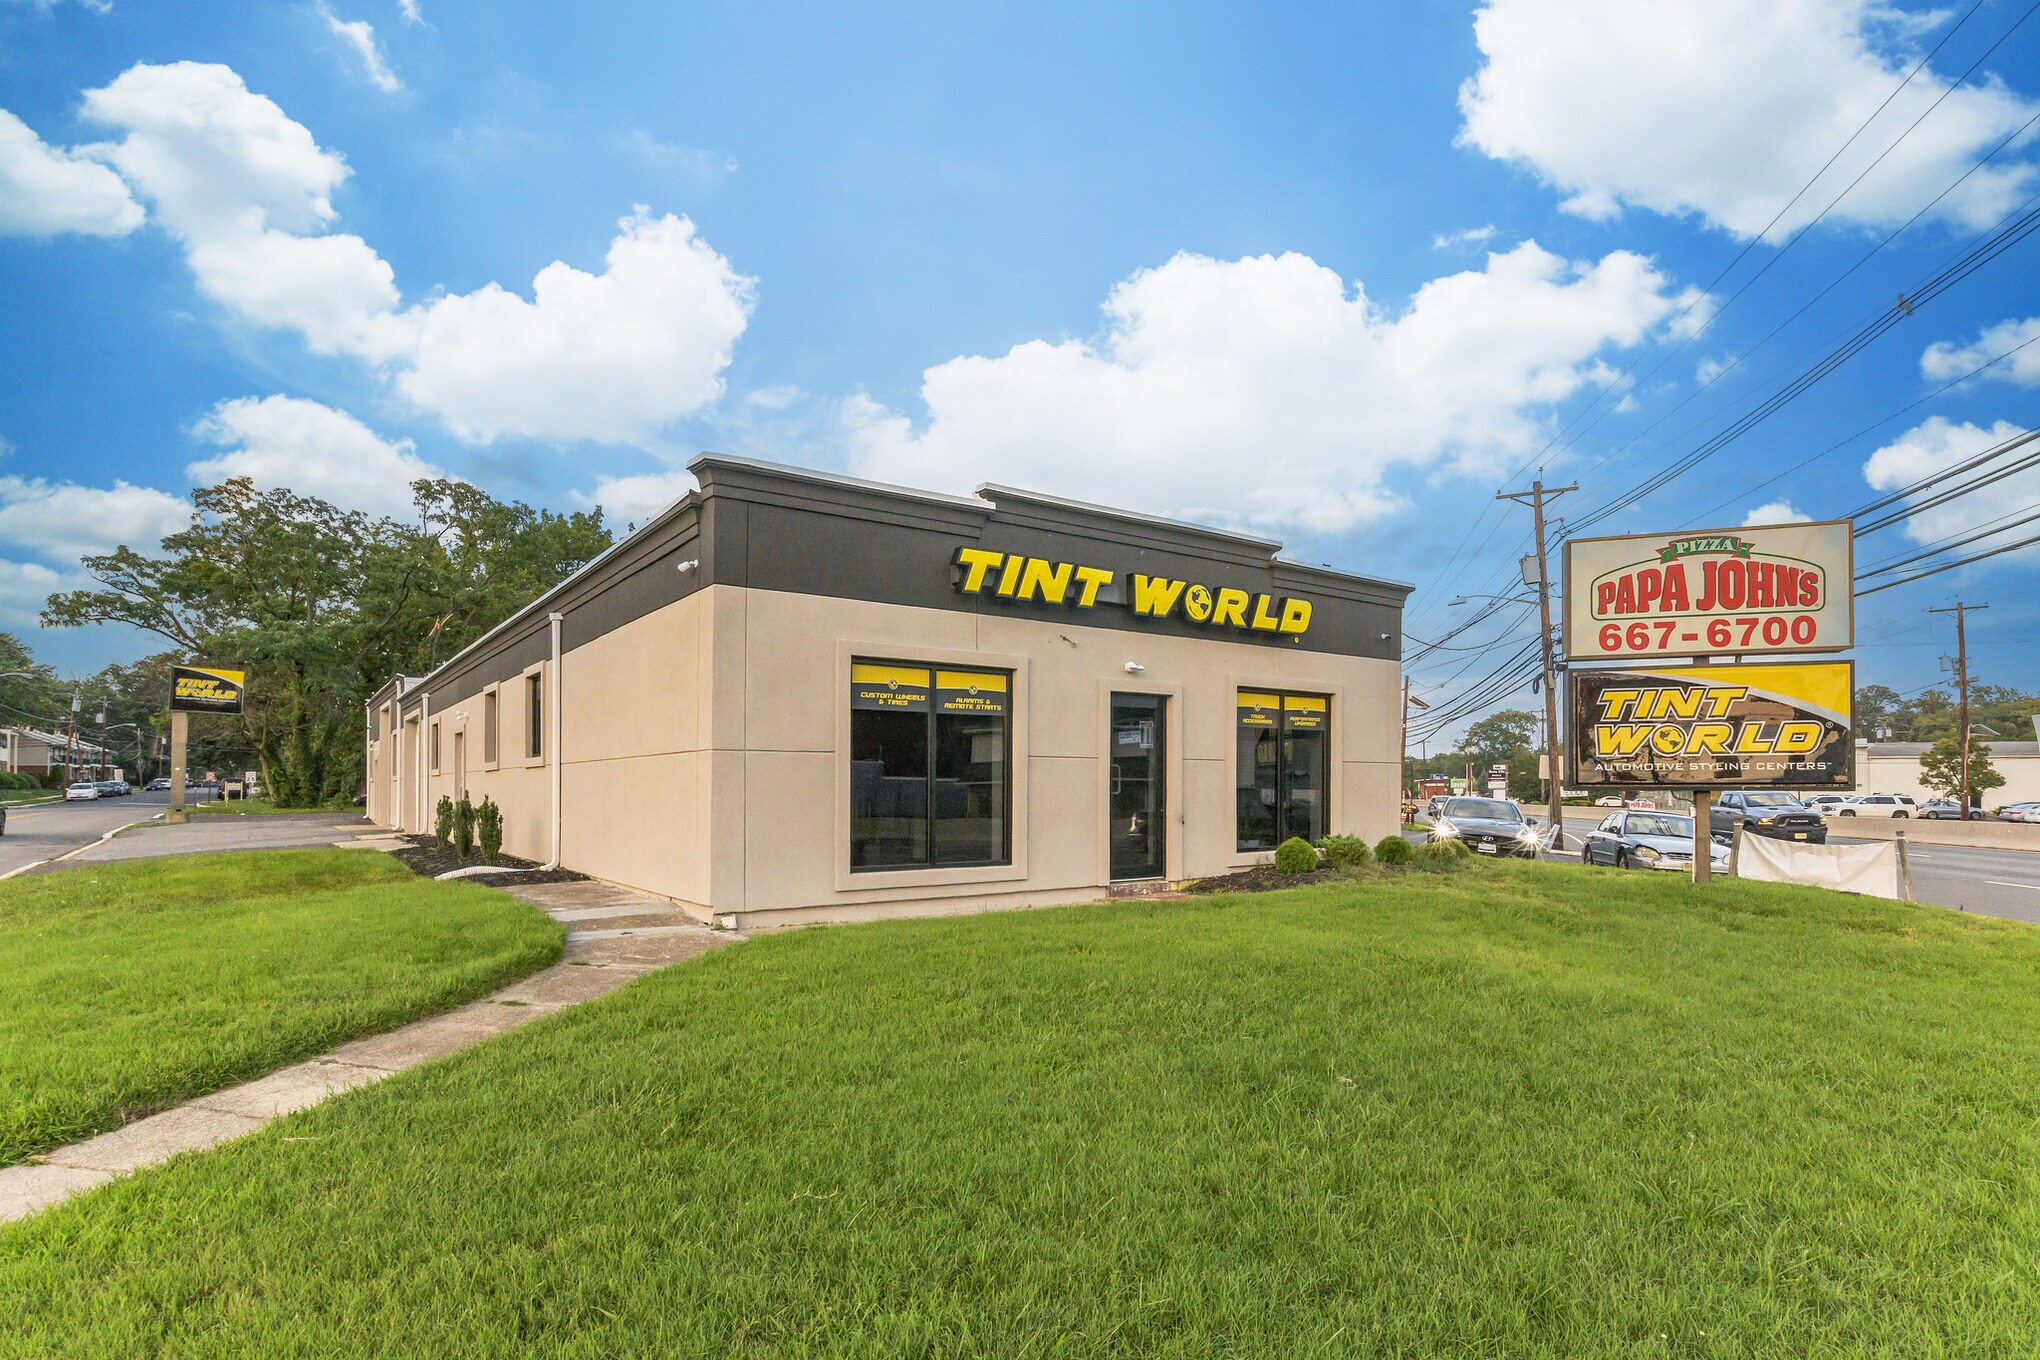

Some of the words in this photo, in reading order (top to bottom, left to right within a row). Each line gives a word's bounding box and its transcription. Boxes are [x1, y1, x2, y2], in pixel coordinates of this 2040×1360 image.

[1675, 538, 1734, 554] PIZZA
[957, 547, 1114, 608] TINT
[1128, 573, 1314, 633] WORLD
[1597, 563, 1690, 615] PAPA
[1696, 559, 1819, 611] JOHN'S
[1598, 615, 1817, 651] 667-6700
[176, 687, 237, 699] WORLD
[177, 678, 220, 688] TINT
[860, 692, 893, 700] CUSTOM
[1596, 686, 1749, 721] TINT
[1595, 721, 1824, 757] WORLD
[1594, 762, 1684, 771] AUTOMOTIVE
[1688, 762, 1750, 771] STYLING
[1755, 761, 1827, 771] CENTERS
